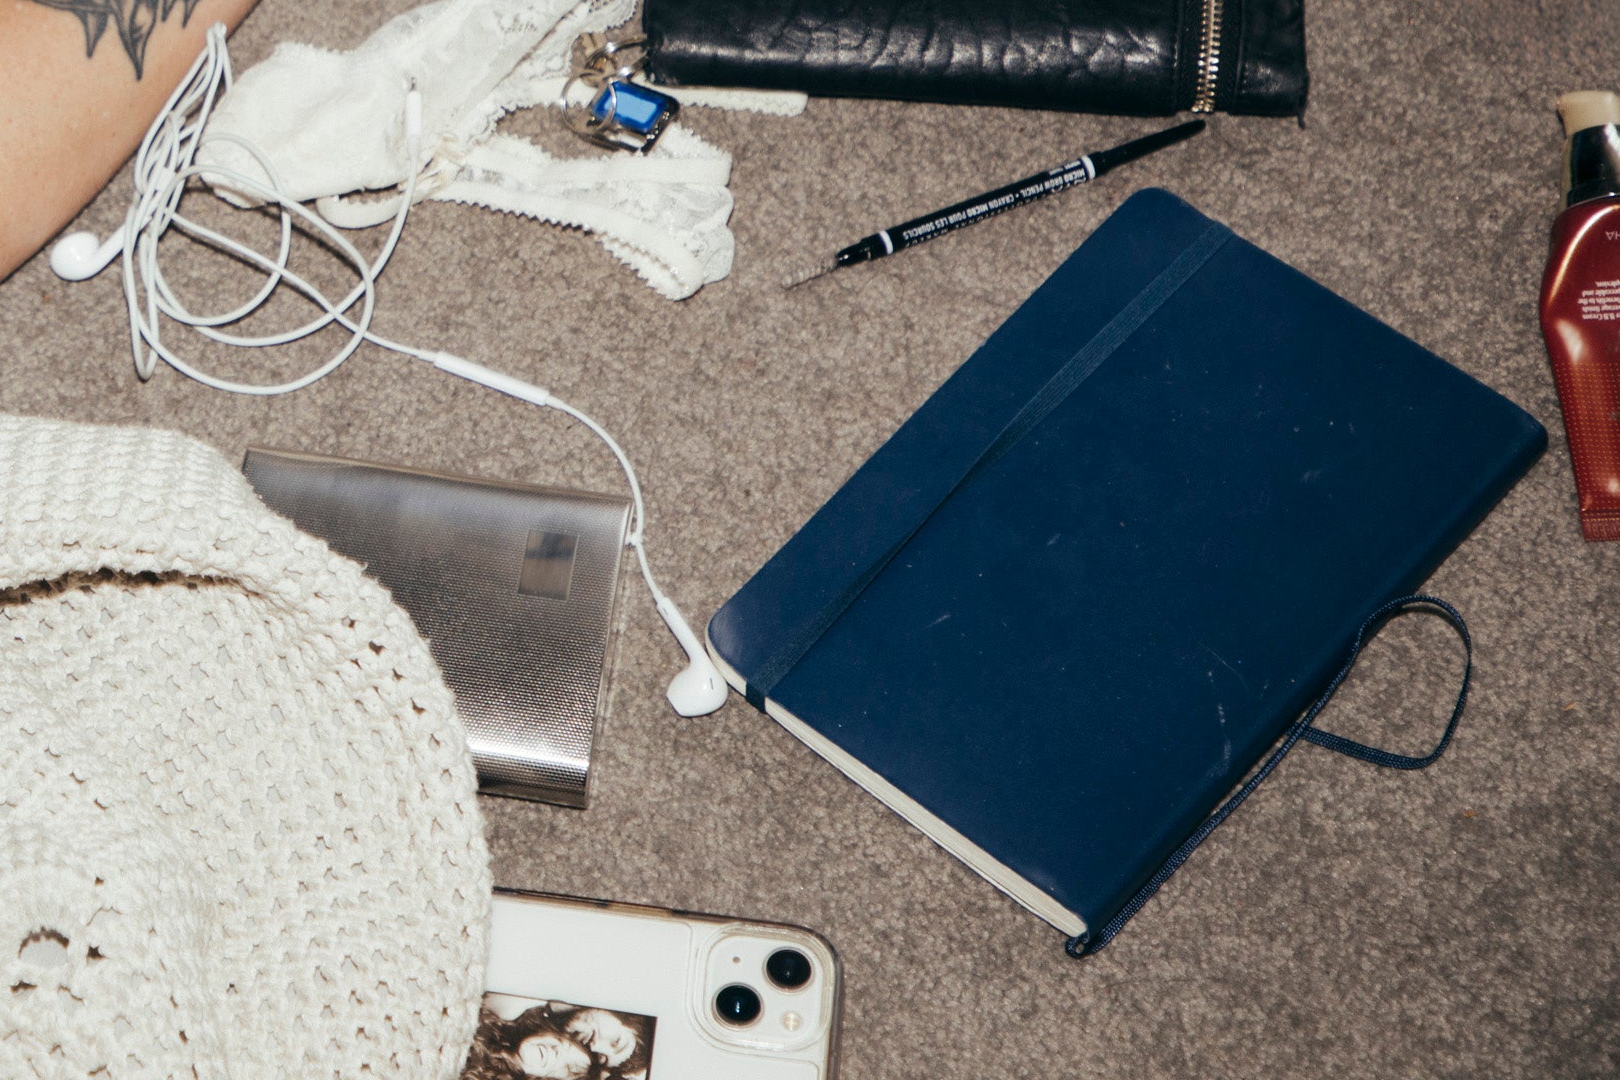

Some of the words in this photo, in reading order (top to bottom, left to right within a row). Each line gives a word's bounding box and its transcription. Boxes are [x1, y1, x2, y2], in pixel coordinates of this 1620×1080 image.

[1042, 175, 1064, 190] BROW
[1062, 167, 1086, 183] MICRO
[1019, 182, 1044, 198] PENCIL
[986, 192, 1015, 210] CRAYON
[947, 209, 967, 224] POUR
[964, 202, 989, 218] MICRO
[901, 220, 936, 240] SOURCILS
[933, 216, 949, 229] LES
